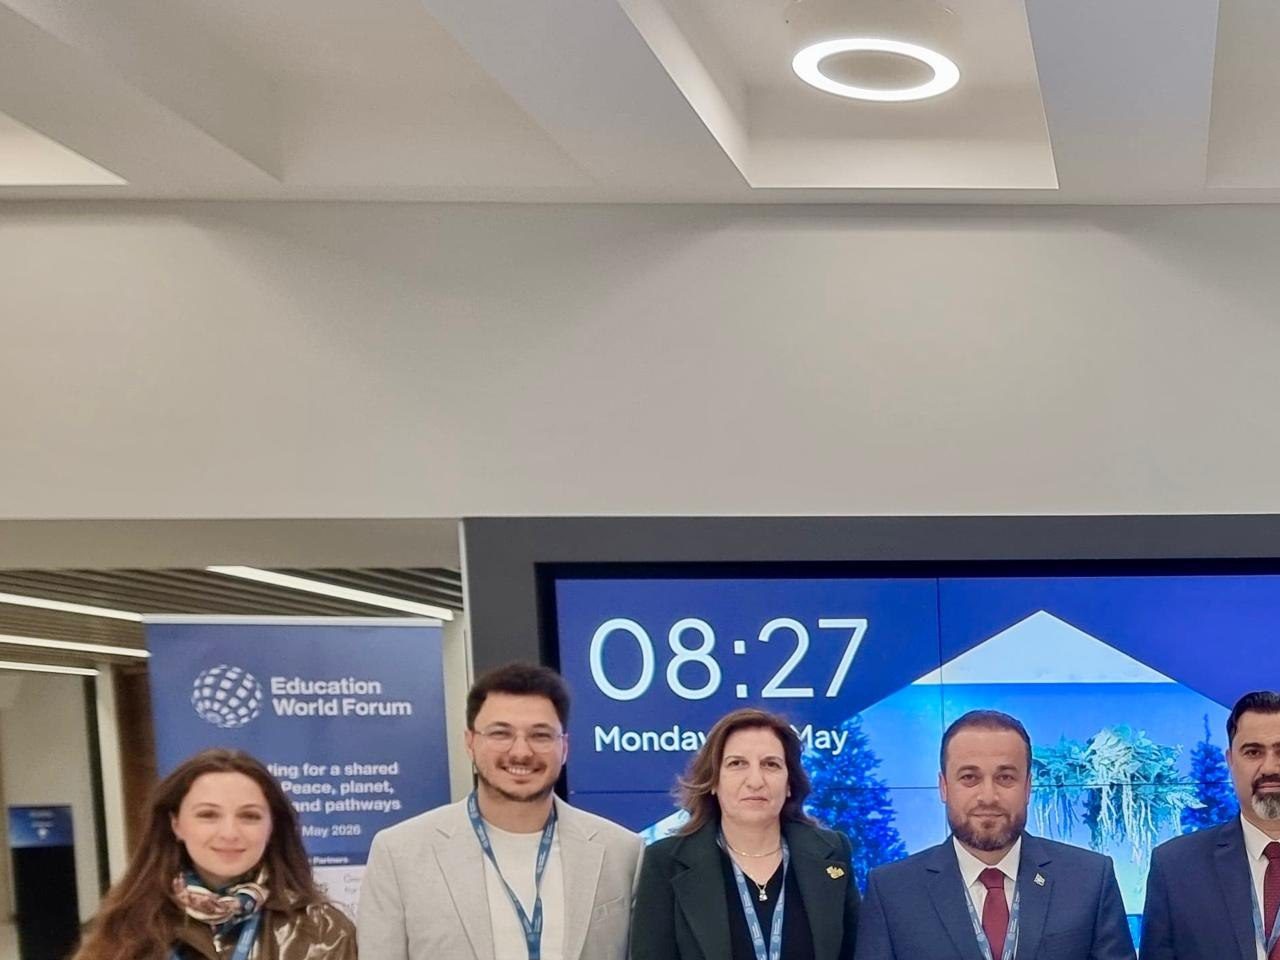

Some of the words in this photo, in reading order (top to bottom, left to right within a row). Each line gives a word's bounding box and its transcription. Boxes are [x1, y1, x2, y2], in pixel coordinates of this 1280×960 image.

[589, 617, 868, 701] 08:27
[270, 676, 382, 695] Education
[272, 698, 339, 716] World
[342, 698, 412, 716] Forum
[303, 762, 326, 776] for
[330, 765, 340, 776] a
[344, 762, 399, 776] shared
[281, 780, 336, 795] Peace,
[340, 780, 394, 795] planet,
[325, 798, 401, 814] pathways
[302, 825, 329, 838] May
[331, 824, 361, 836] 2026
[313, 856, 349, 865] Partners
